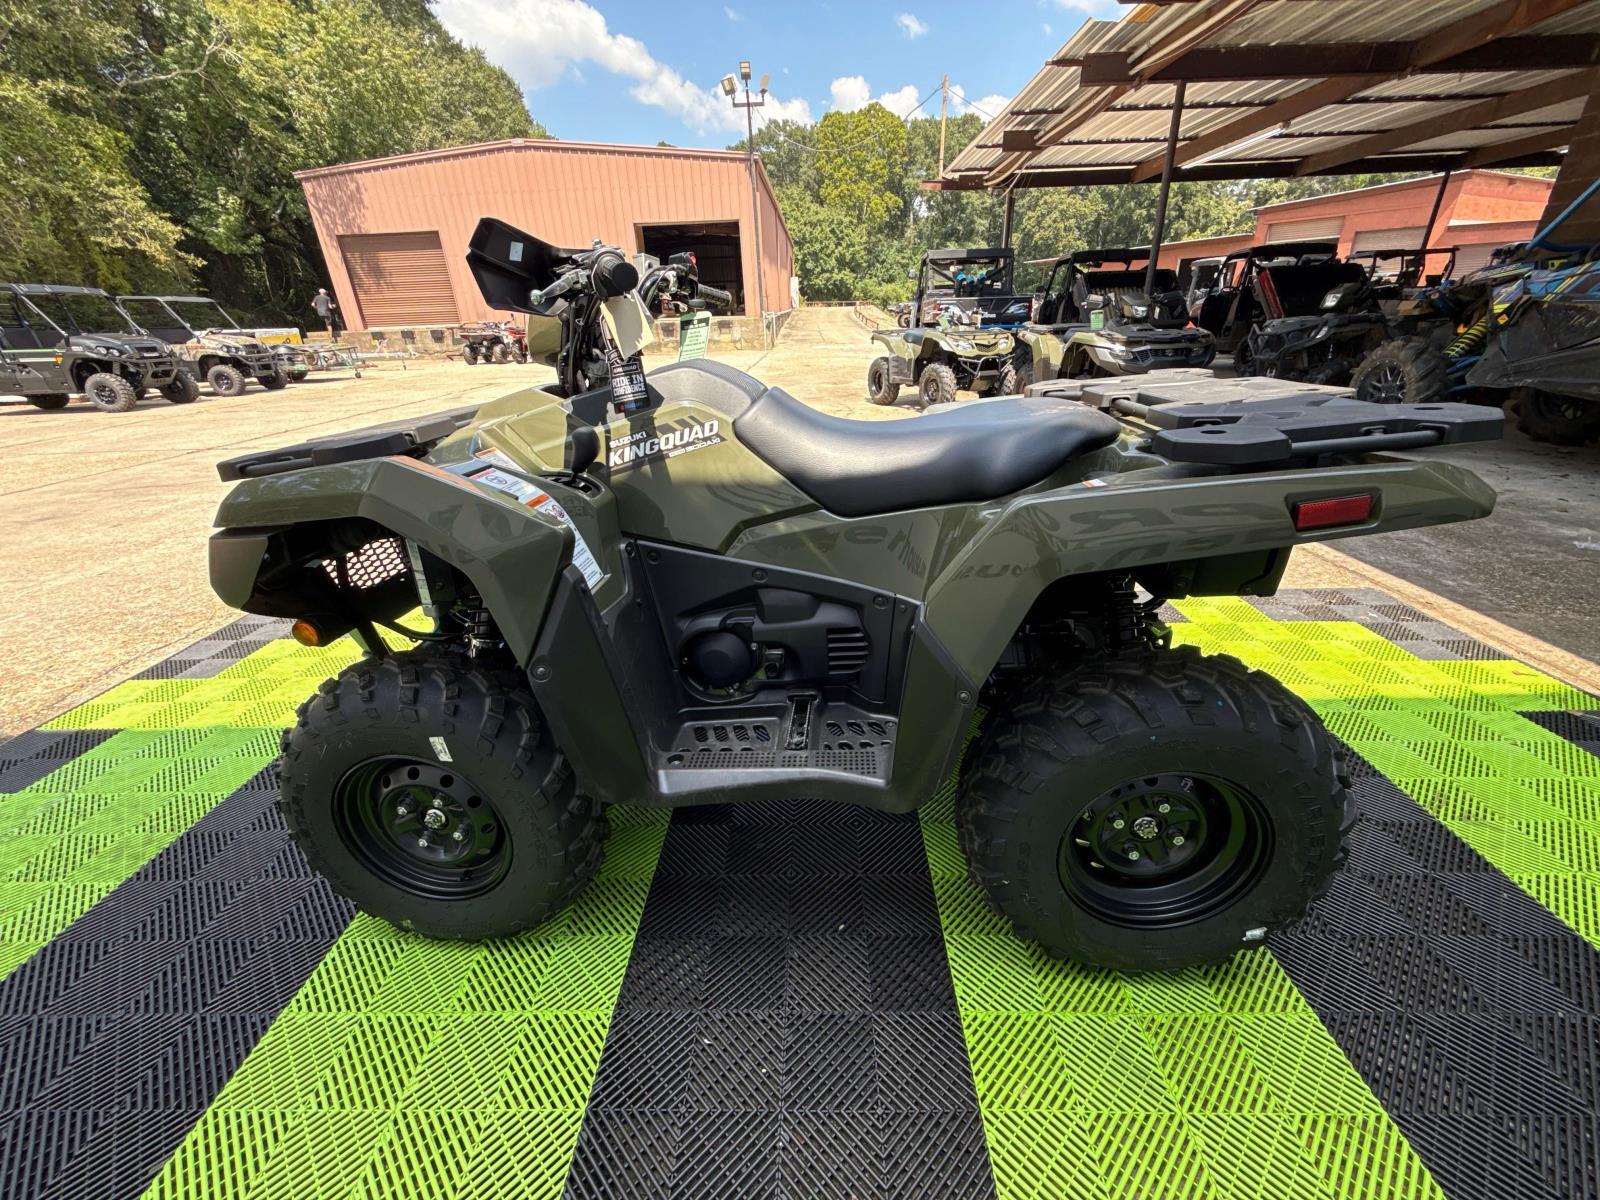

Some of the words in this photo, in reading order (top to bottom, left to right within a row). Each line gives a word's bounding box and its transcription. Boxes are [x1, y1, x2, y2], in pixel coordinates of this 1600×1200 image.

[612, 376, 631, 388] RIDE
[631, 374, 644, 384] IN
[613, 383, 645, 396] CONFIDENCE
[609, 431, 647, 449] SUZUKI
[609, 420, 719, 467] KINGQUAD
